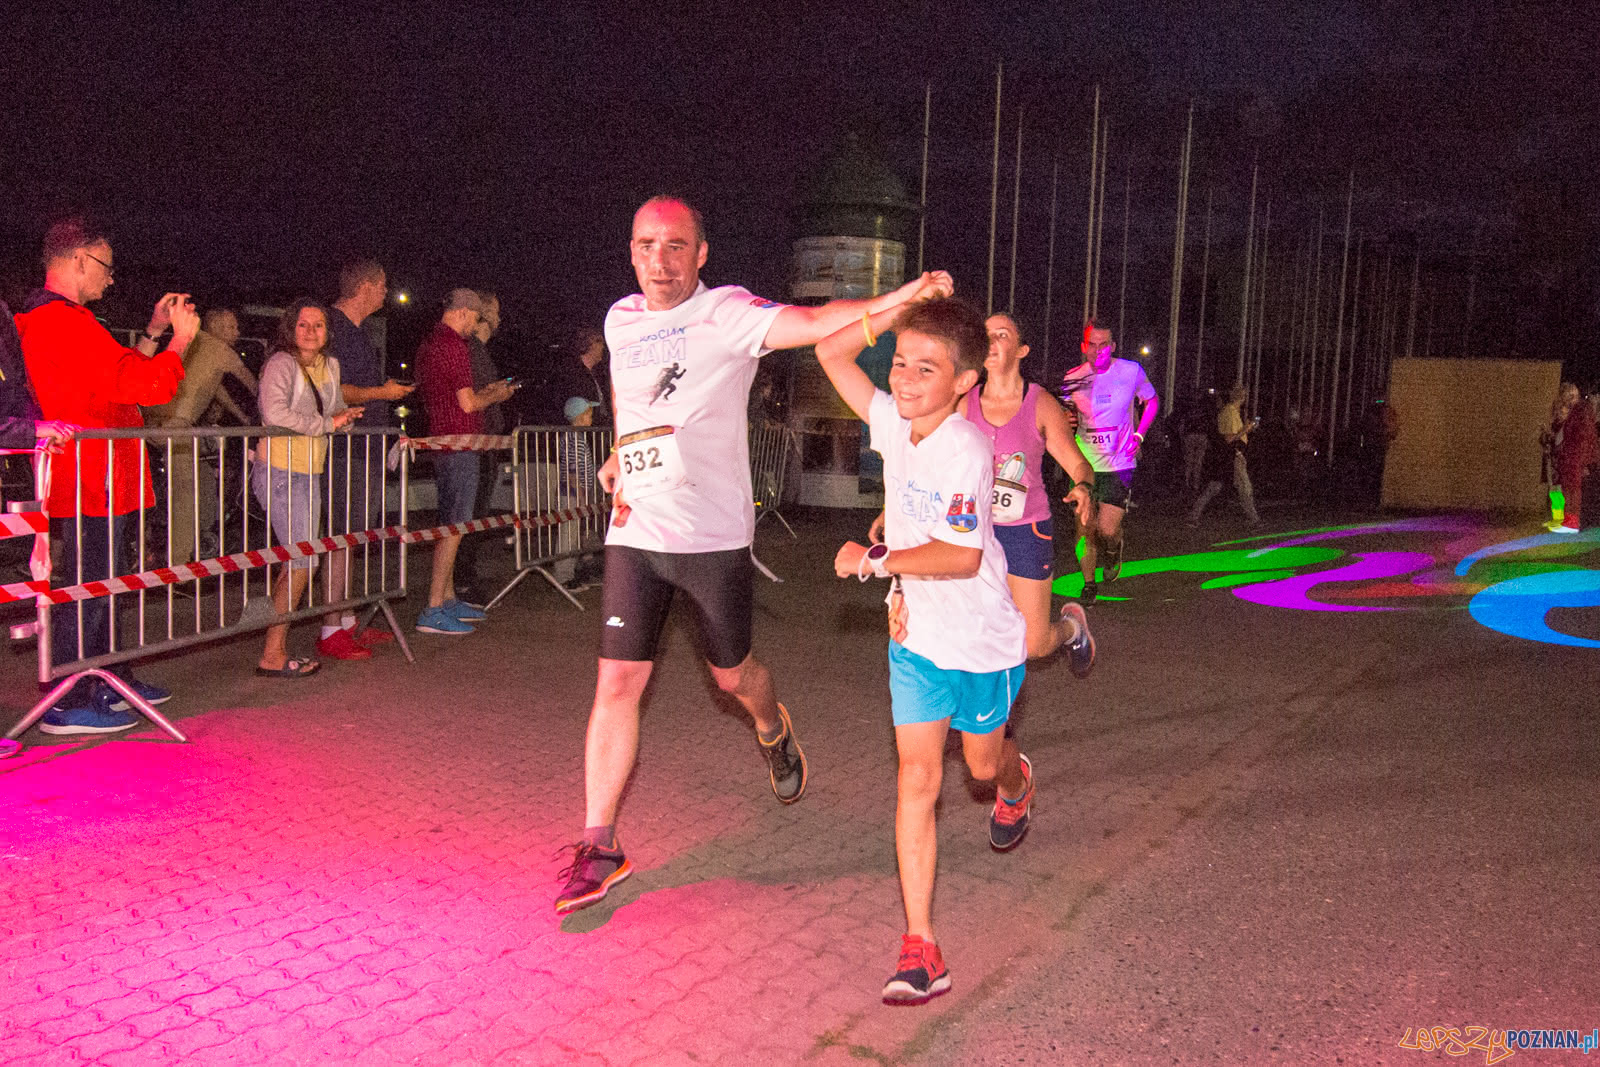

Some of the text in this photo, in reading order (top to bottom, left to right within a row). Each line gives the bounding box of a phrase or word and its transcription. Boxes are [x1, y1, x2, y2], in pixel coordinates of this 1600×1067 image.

[616, 337, 687, 371] TEAM
[1091, 434, 1112, 445] 281
[623, 446, 664, 475] 632
